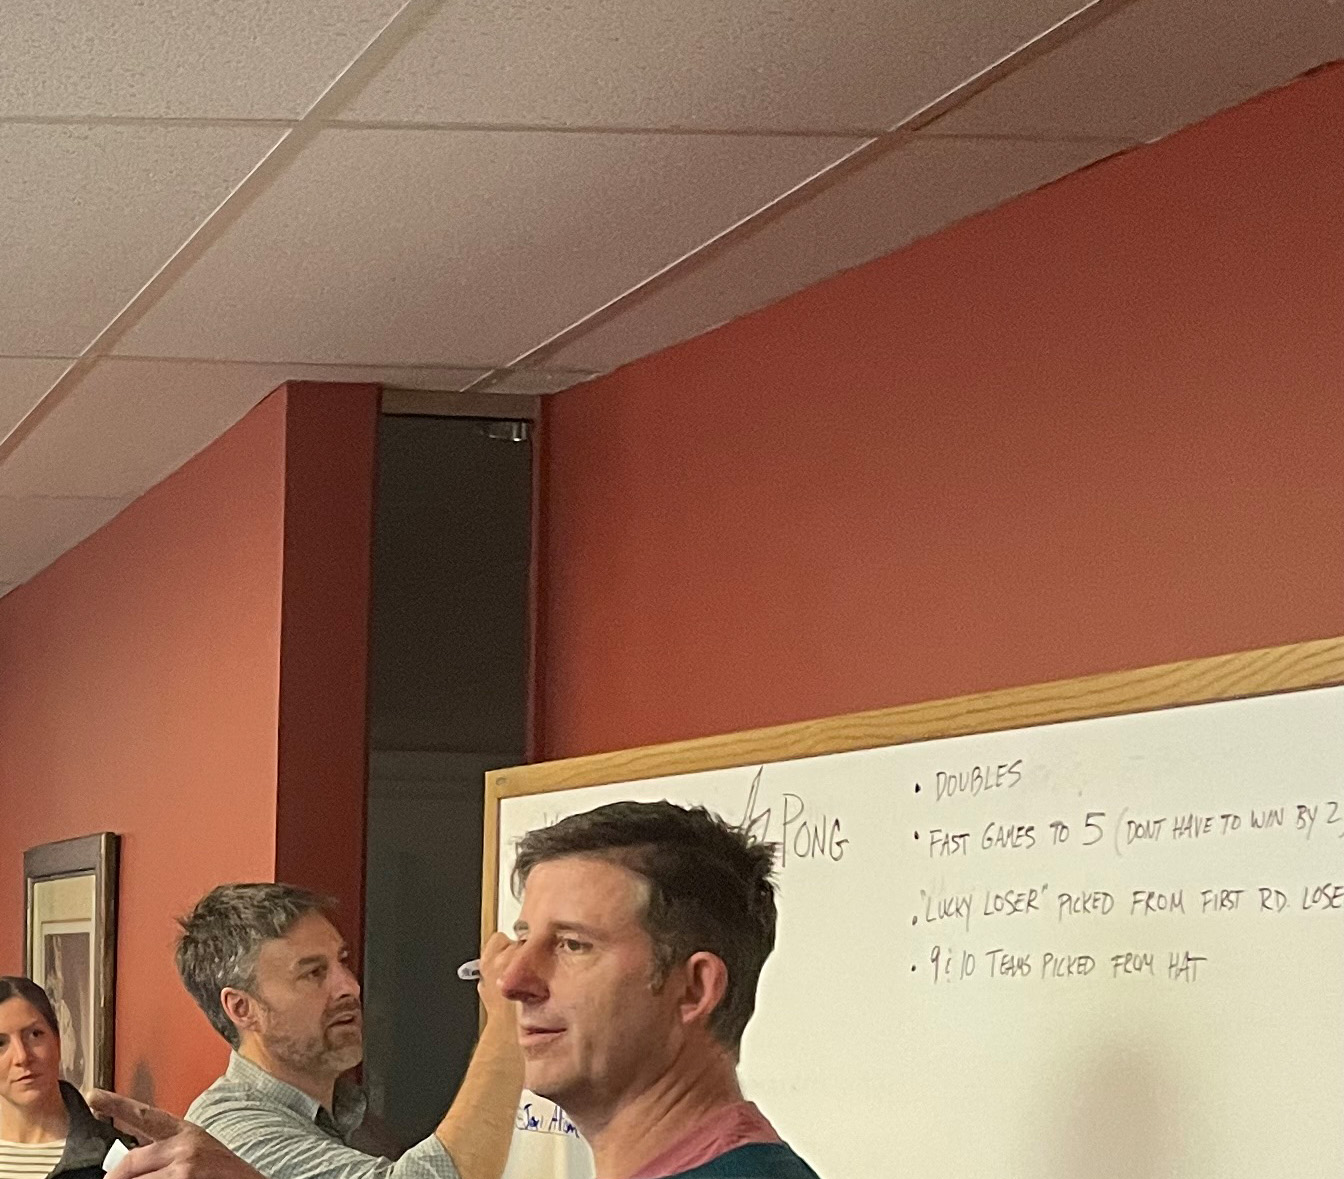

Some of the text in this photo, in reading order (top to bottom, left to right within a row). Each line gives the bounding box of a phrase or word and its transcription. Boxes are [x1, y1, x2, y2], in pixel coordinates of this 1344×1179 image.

[935, 759, 1023, 801] DOUBLES
[929, 828, 971, 858] FAST
[981, 822, 1037, 850] GAMES
[1049, 820, 1070, 845] TO
[1082, 811, 1106, 846] 5
[1172, 813, 1215, 839] HAVE
[1220, 813, 1242, 835] TO
[1250, 807, 1285, 829] WIN
[1296, 804, 1318, 841] BY
[1057, 890, 1115, 922] PICKED
[1129, 888, 1186, 916] FROM
[1200, 888, 1245, 914] FIRST
[930, 944, 941, 985] 9
[959, 949, 976, 981] 10
[1041, 951, 1095, 979] PICKED
[1111, 951, 1155, 979] FROM
[1169, 950, 1208, 983] HAT
